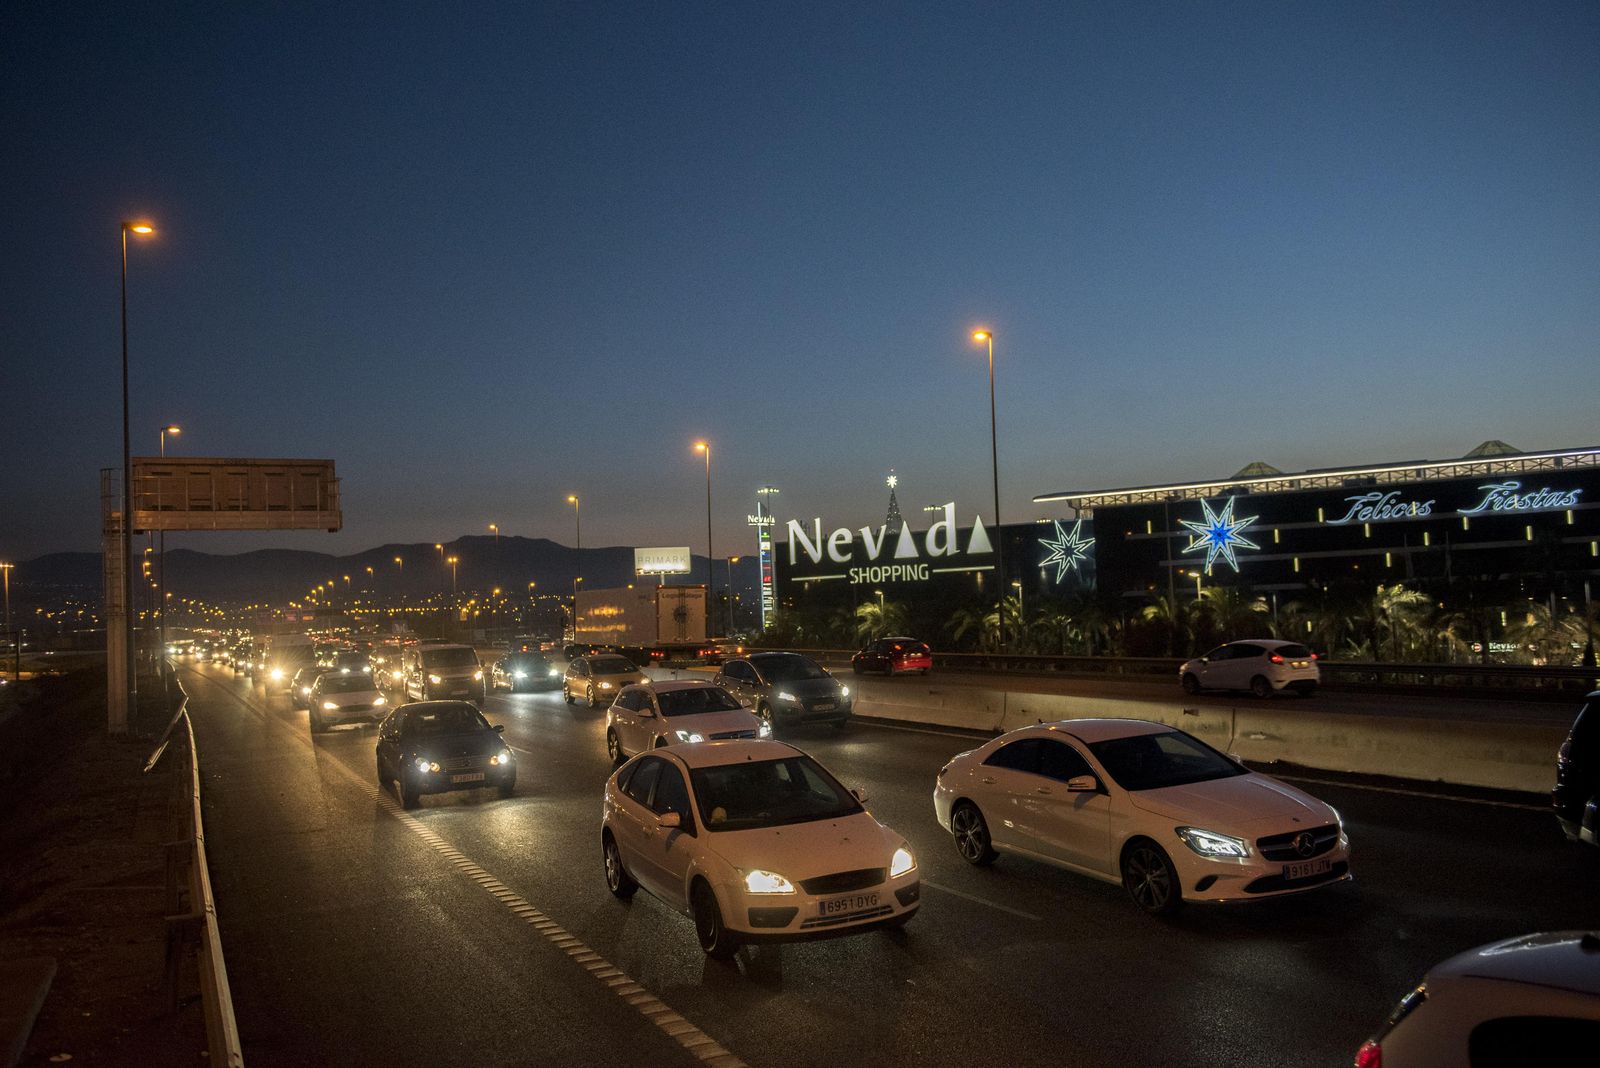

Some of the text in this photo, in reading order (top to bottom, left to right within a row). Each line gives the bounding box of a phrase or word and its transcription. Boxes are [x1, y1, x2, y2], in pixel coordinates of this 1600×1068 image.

[1326, 481, 1583, 524] Felices Fiestas
[786, 501, 994, 566] Nevada
[637, 555, 688, 565] PRIMARK
[849, 564, 929, 584] SHOPPING
[827, 894, 877, 913] 6951 DYG
